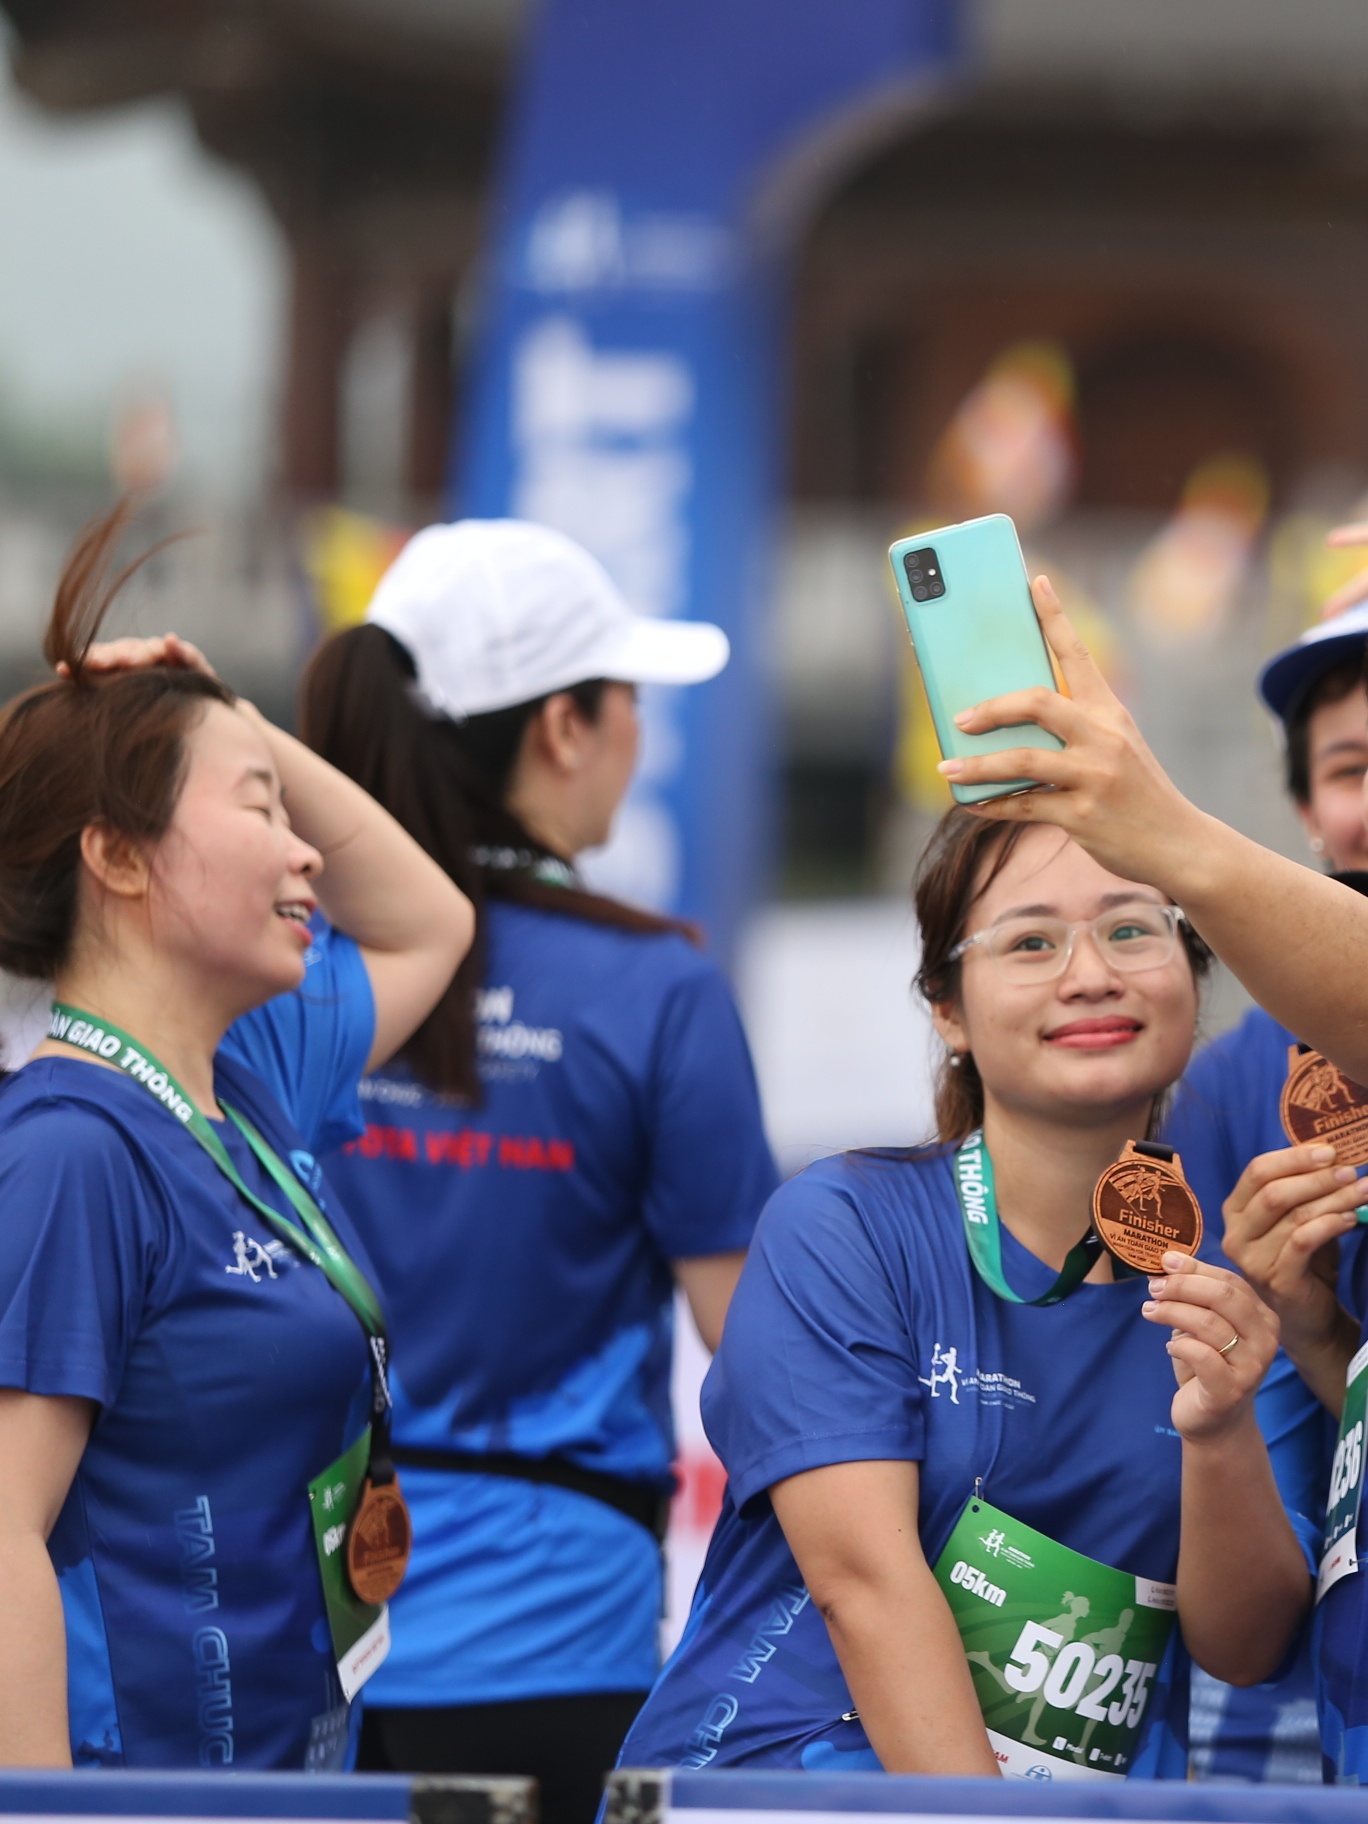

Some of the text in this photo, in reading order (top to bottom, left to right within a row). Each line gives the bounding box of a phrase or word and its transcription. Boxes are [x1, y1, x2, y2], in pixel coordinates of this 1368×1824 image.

[67, 1020, 122, 1058] GIAO
[120, 1046, 193, 1123] THÔNG
[343, 1124, 417, 1162] OTA
[958, 1150, 989, 1225] THÔNG
[1119, 1207, 1180, 1239] Finisher
[1123, 1228, 1169, 1249] MARATHON
[174, 1495, 219, 1617] TAM
[950, 1560, 1007, 1608] 05km
[727, 1583, 811, 1684] TAM
[1004, 1620, 1157, 1729] 50235
